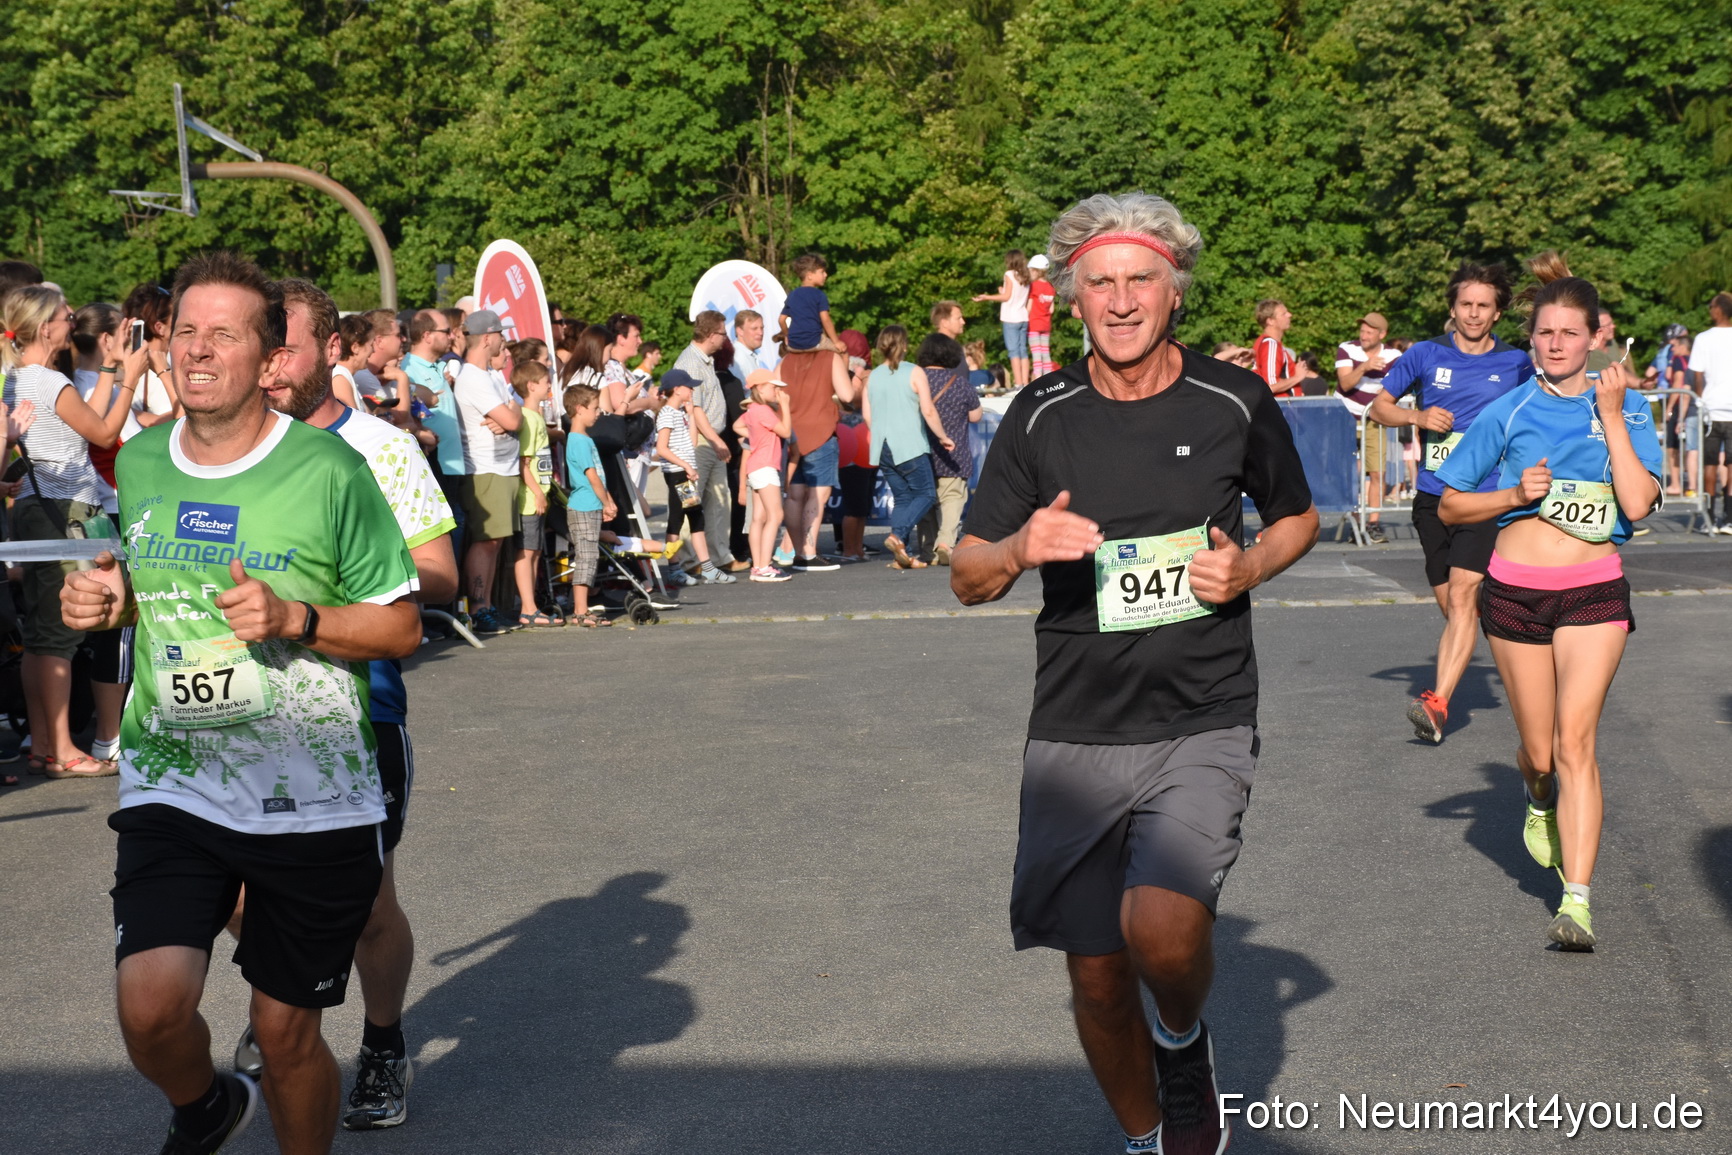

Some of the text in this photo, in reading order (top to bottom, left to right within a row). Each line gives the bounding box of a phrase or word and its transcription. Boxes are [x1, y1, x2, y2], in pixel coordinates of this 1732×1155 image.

[1046, 381, 1066, 394] JAKO
[1176, 446, 1191, 456] EDI
[1431, 445, 1450, 461] 20
[1548, 501, 1607, 524] 2021
[189, 517, 234, 530] Fischer
[146, 532, 298, 572] firmenlauf
[1111, 554, 1157, 567] firmenlauf
[1183, 553, 1194, 563] 20
[145, 561, 207, 573] neumarkt
[133, 582, 192, 602] esunde
[1119, 564, 1187, 604] 947
[150, 603, 213, 623] laufen
[1112, 612, 1152, 623] Grundschule
[1161, 606, 1173, 617] der
[1173, 602, 1200, 614] Bräugass
[1124, 596, 1191, 615] Dengel Eduard
[172, 667, 235, 705] 567
[170, 698, 252, 715] Fürnrieder Markus
[175, 707, 247, 721] Dekra Automobil GmbH
